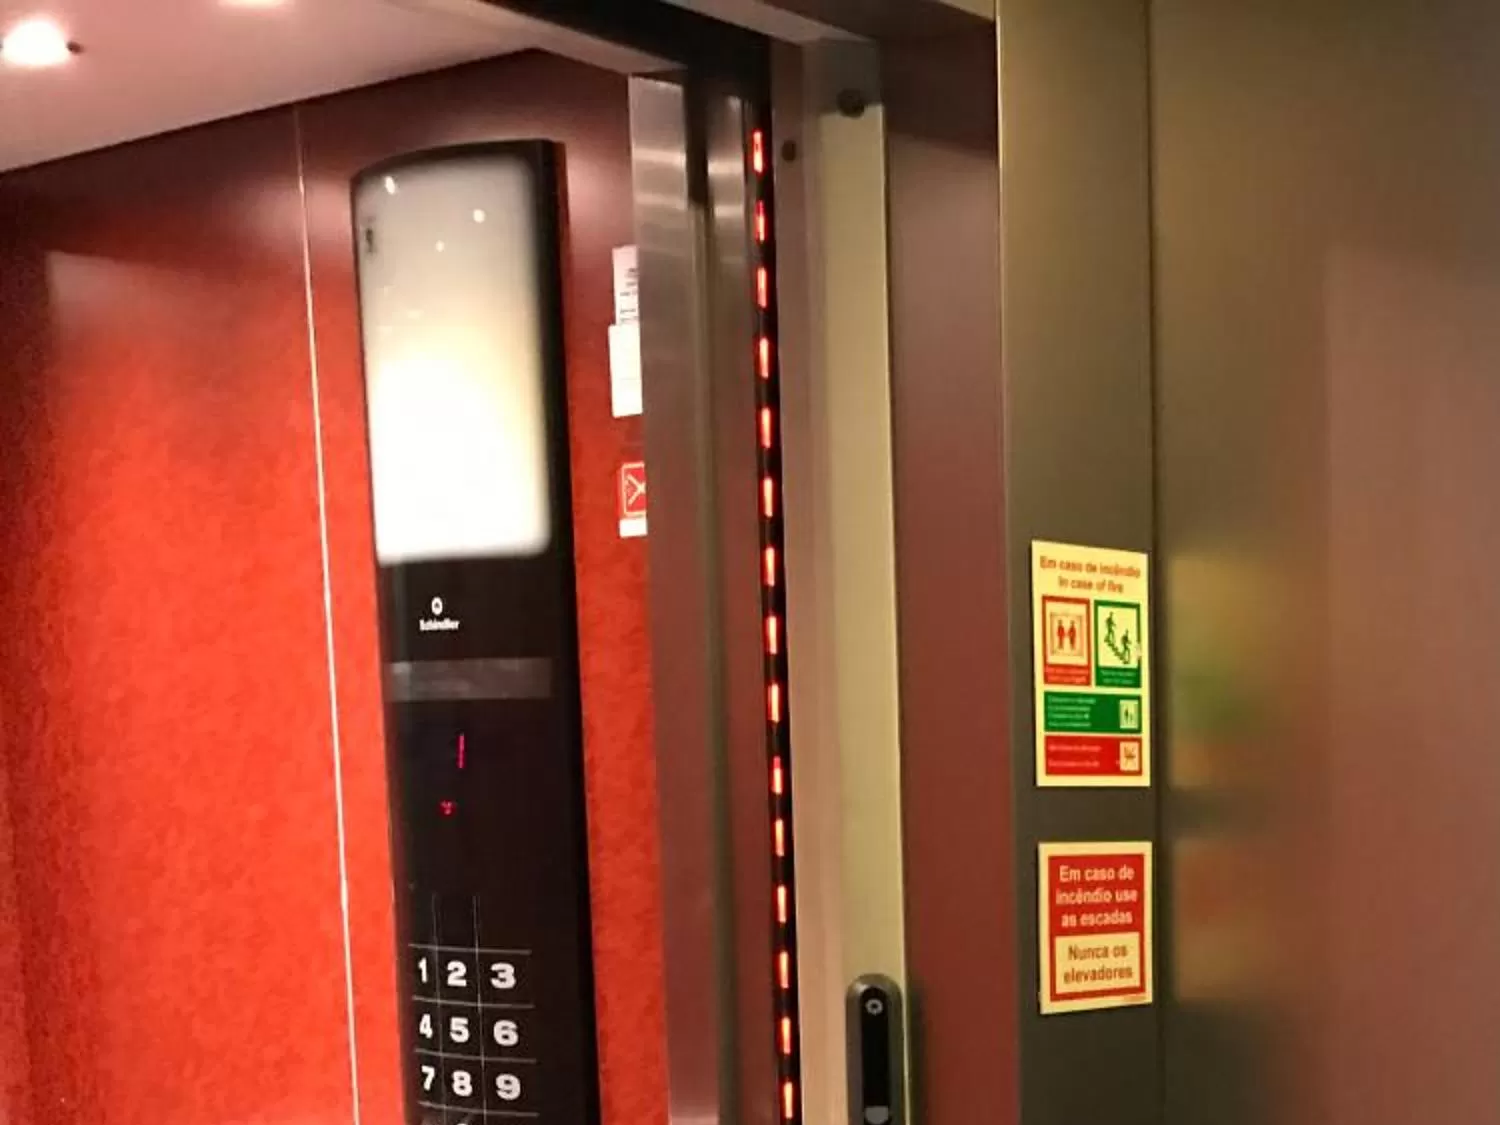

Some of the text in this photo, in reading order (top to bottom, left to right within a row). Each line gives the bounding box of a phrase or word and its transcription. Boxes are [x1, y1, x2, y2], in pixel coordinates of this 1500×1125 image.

[1040, 555, 1057, 569] Em
[1060, 560, 1083, 573] caso
[1086, 563, 1097, 573] de
[1058, 576, 1124, 593] In case of fire
[1059, 864, 1135, 882] Em caso de
[1115, 889, 1138, 902] use
[1061, 909, 1133, 927] as escadas
[1068, 944, 1128, 961] Nunca os
[418, 957, 516, 989] 1 2 3
[1063, 965, 1133, 985] elevadores
[419, 1013, 519, 1046] 4 5 6
[421, 1065, 521, 1100] 7 8 9
